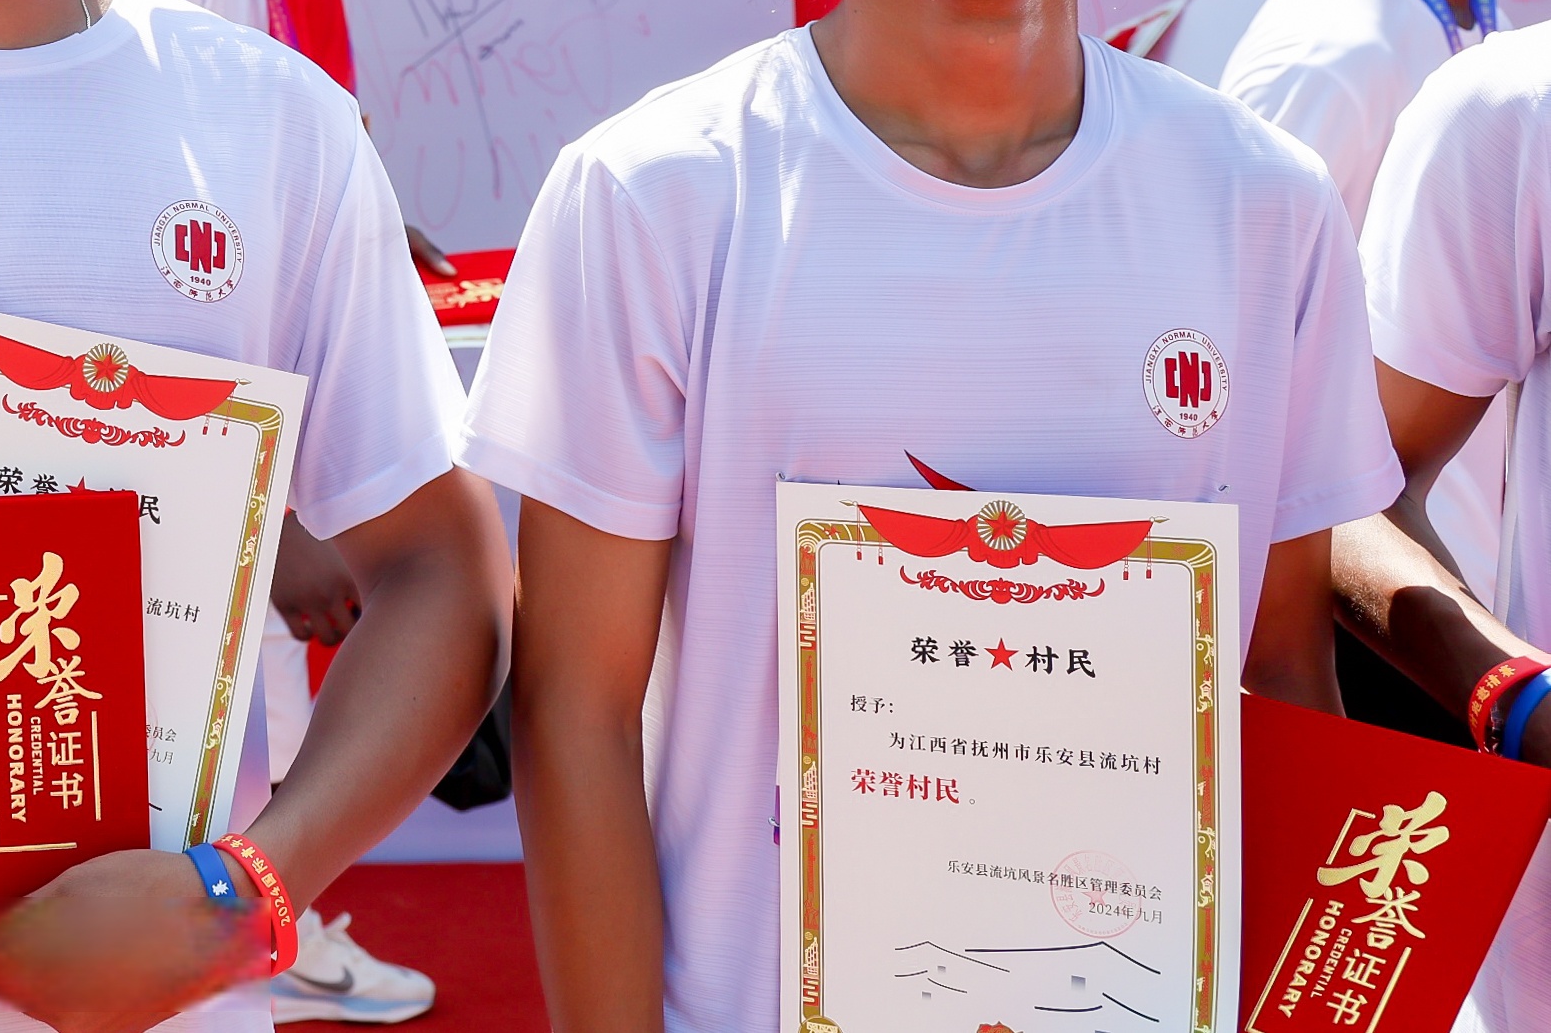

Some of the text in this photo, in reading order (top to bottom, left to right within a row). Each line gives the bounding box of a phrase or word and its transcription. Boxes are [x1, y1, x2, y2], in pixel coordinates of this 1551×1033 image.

[172, 202, 210, 213] NORMAL
[215, 210, 242, 263] UNIVERSITY
[190, 275, 211, 286] 1940
[1162, 331, 1197, 345] NORMAL
[1201, 337, 1227, 392] UNIVERSITY
[1179, 412, 1198, 422] 1940
[6, 694, 27, 823] HONORARY
[30, 716, 44, 796] CREDENTIAL
[888, 731, 1163, 776] 为江西省抚州市乐安县流坑村
[1088, 901, 1163, 926] 2024年九月
[1278, 899, 1345, 1019] HONORARY
[1310, 927, 1353, 999] CREDENTIAL
